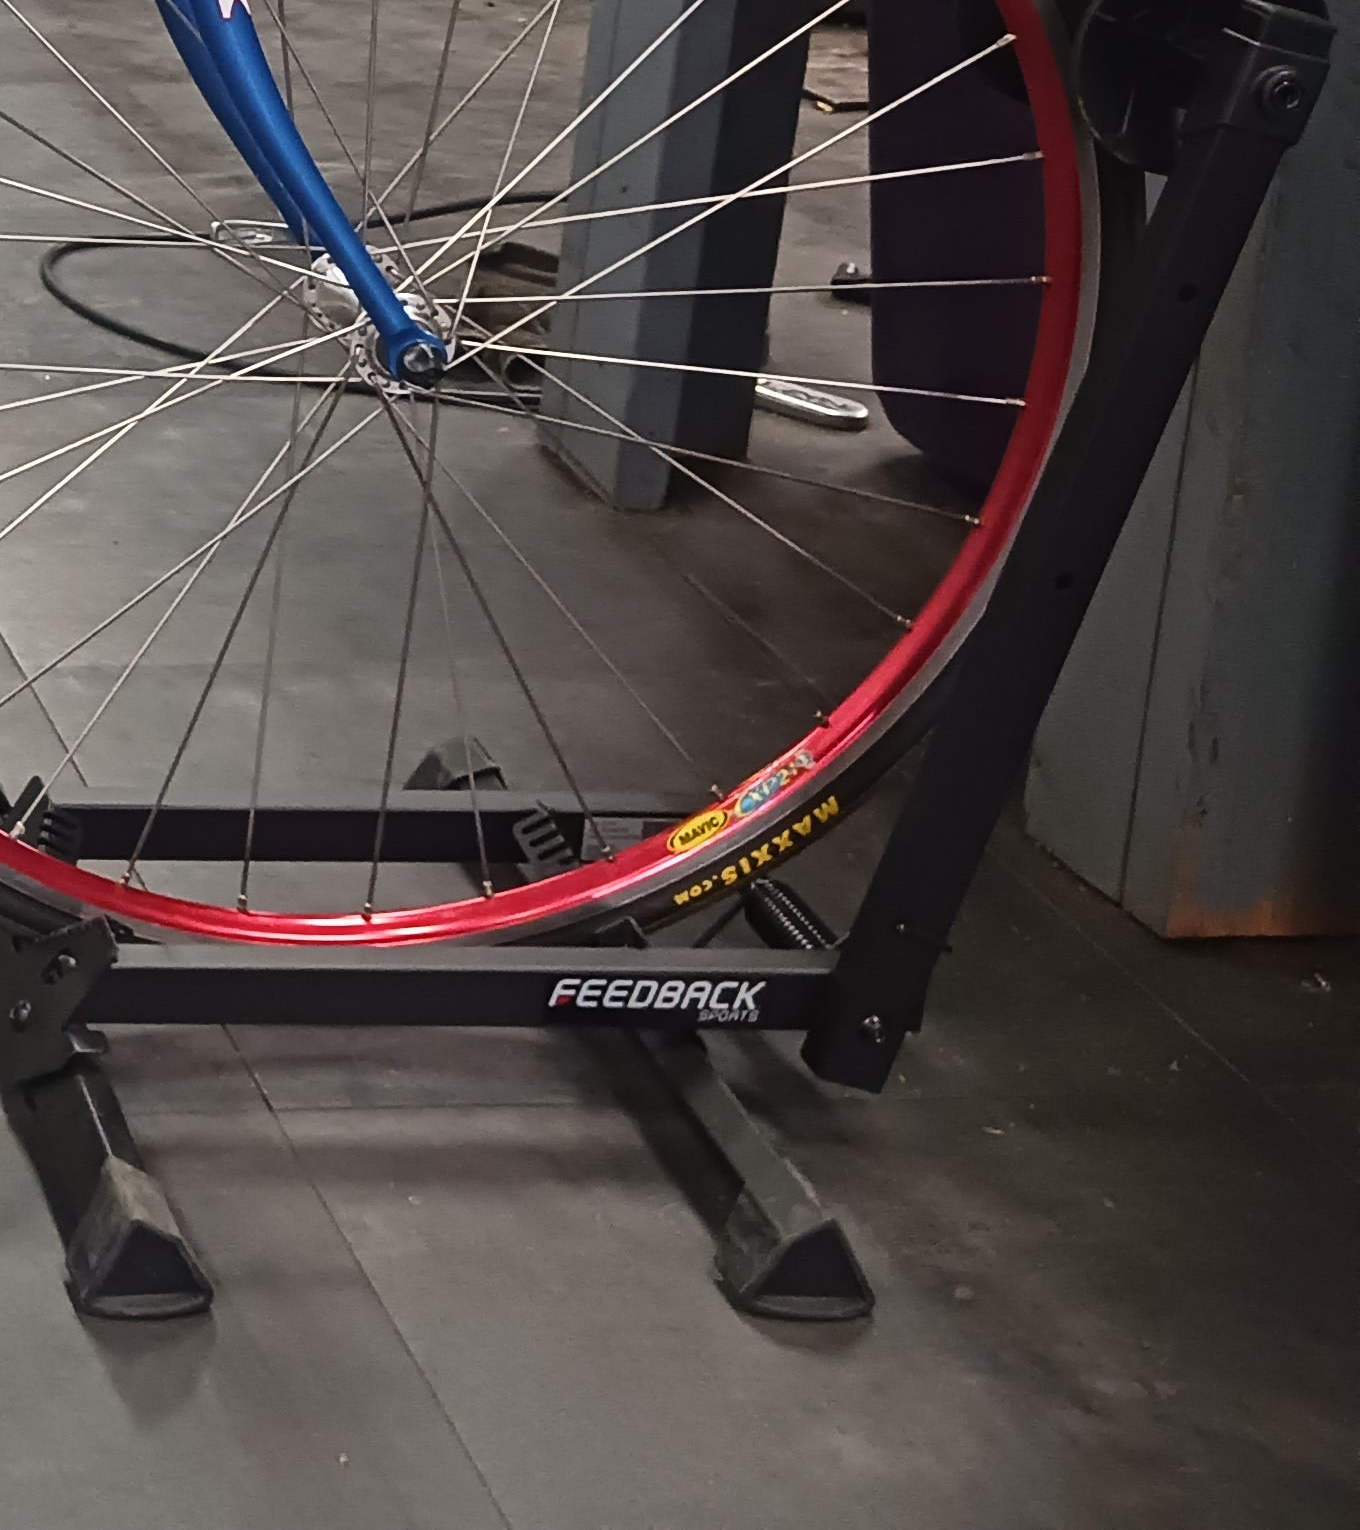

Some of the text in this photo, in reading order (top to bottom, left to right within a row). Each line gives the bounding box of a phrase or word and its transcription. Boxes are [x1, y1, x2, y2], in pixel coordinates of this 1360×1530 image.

[678, 814, 721, 846] MAVIC
[673, 795, 840, 907] MAXXIS.COM
[548, 978, 767, 1011] FEEDBACK
[697, 1007, 761, 1023] SPORTS
